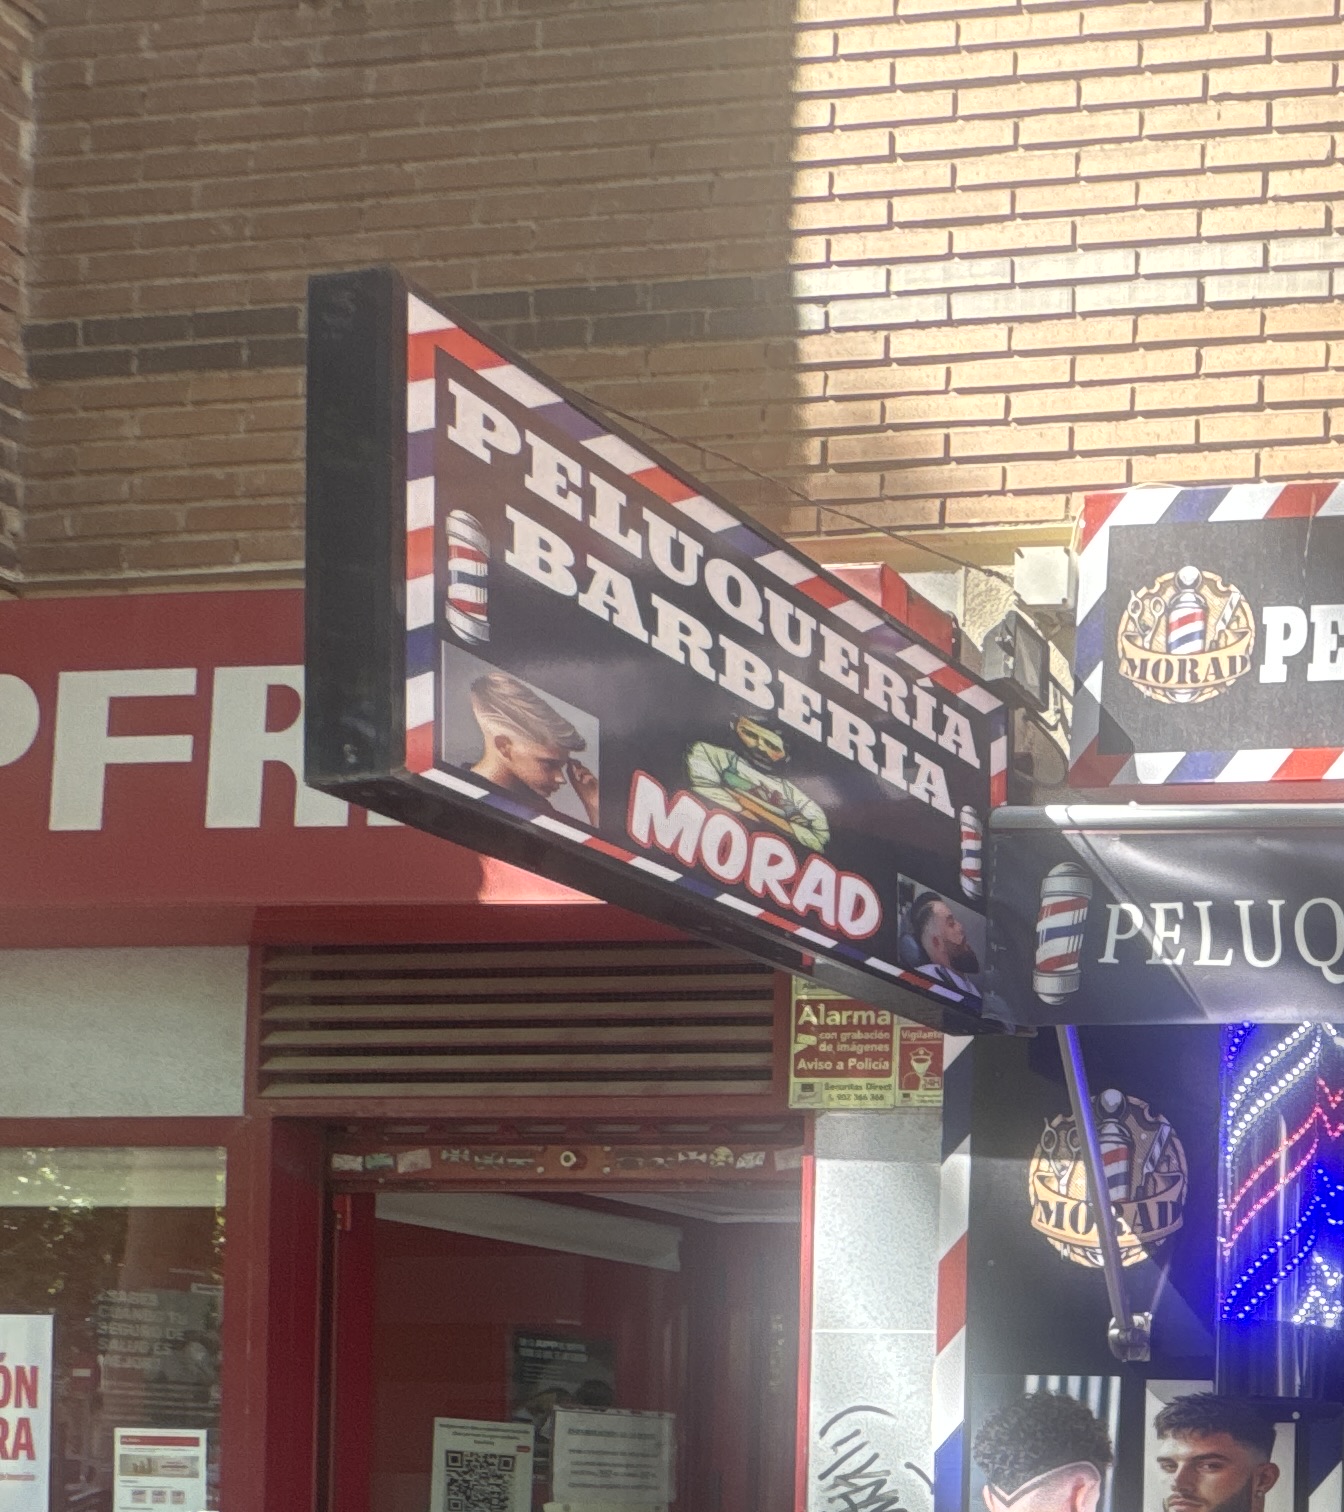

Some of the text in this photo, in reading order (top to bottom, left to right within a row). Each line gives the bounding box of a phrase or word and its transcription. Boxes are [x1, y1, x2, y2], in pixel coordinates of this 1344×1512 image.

[446, 378, 981, 769] PELUQUERÍA
[504, 503, 957, 818] BARBERIA
[1125, 654, 1252, 686] MORAD
[627, 770, 882, 940] MORAD
[797, 1003, 891, 1026] Alarma
[818, 1031, 890, 1042] con grabación
[818, 1042, 890, 1054] de imágenes
[797, 1058, 890, 1070] Aviso a Policía
[865, 1083, 892, 1091] Direct
